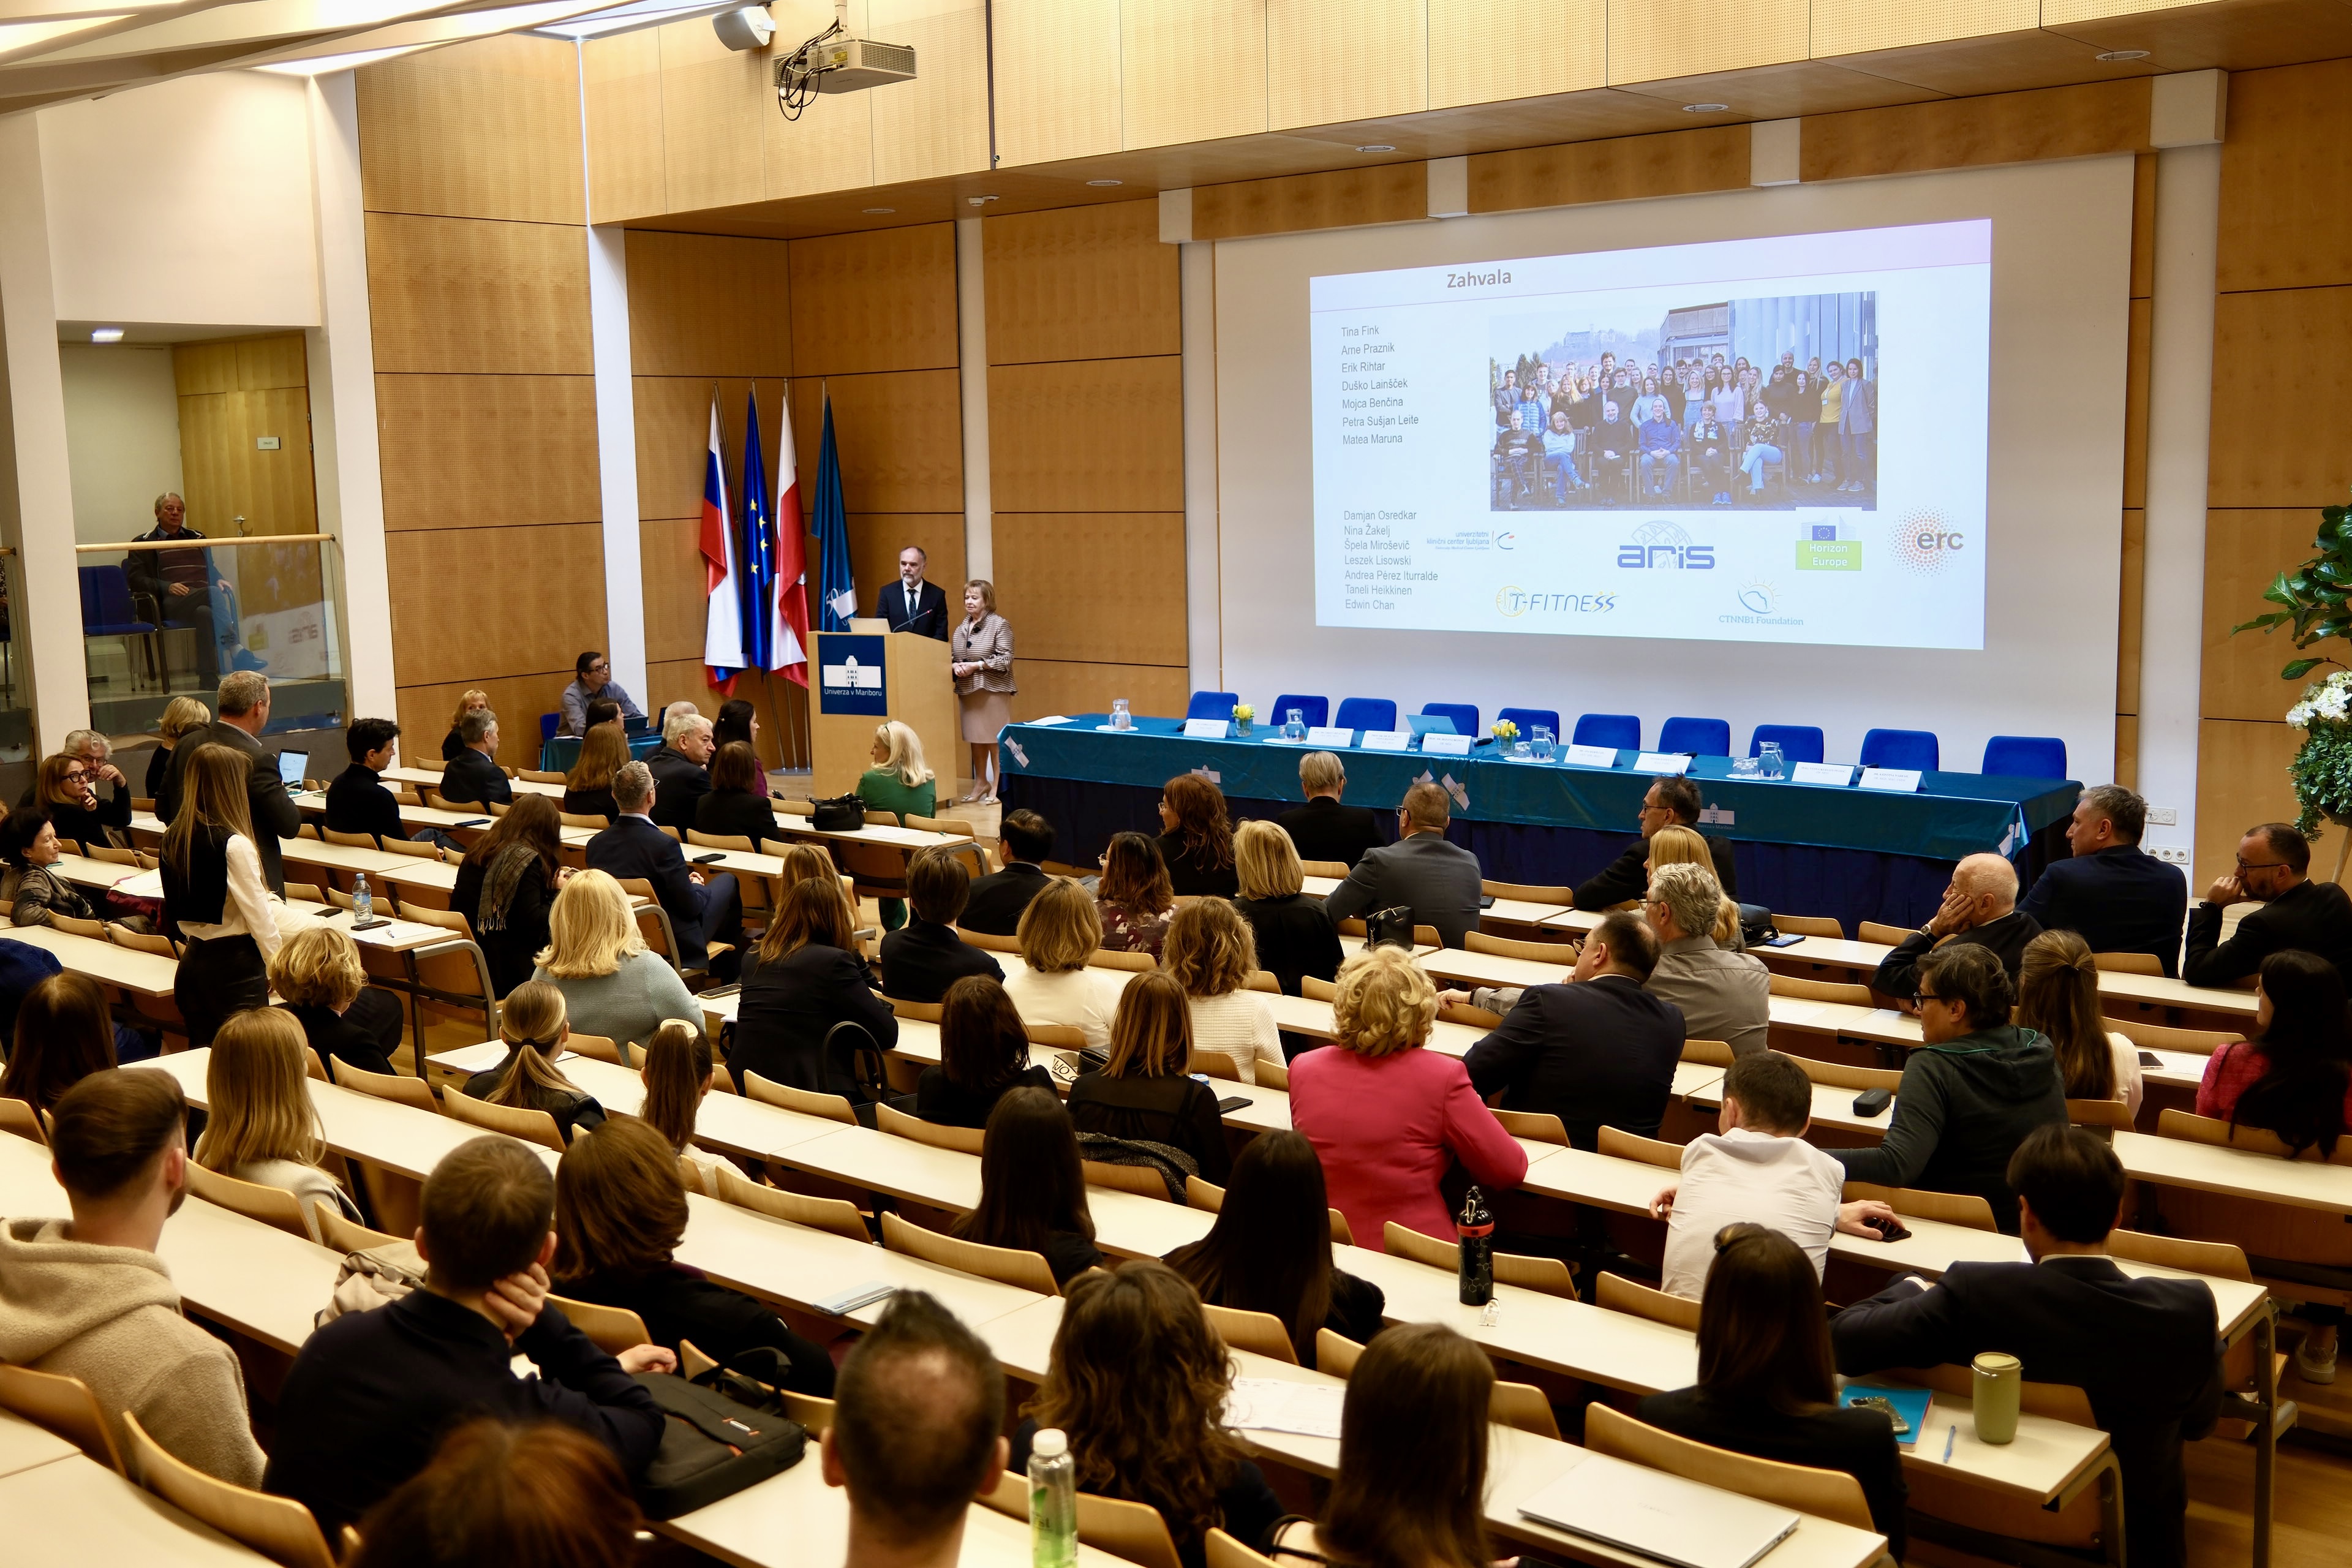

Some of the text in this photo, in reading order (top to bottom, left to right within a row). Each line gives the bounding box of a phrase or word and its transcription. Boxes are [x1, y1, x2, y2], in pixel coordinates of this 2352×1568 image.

[1447, 269, 1512, 288] Zahvala
[1341, 325, 1379, 337] Tina Fink
[1341, 342, 1395, 355] Arne Praznik
[1342, 361, 1385, 373] Erik Rihtar
[1342, 379, 1408, 391] Duško Lainšček
[1342, 397, 1403, 411] Mojca Benčina
[1343, 415, 1419, 428] Petra Sušjan Leite
[1343, 433, 1403, 445] Matea Maruna
[1344, 510, 1417, 522] Damjan Osredkar
[1344, 523, 1390, 538] Nina Žakelj
[1344, 538, 1368, 552] Špela
[1917, 532, 1964, 550] erc
[1809, 543, 1848, 553] Horizon
[1344, 555, 1411, 565] Leszek Lisowski
[1618, 545, 1715, 569] aris
[1812, 557, 1848, 568] Europe
[1344, 570, 1374, 580] Andrea
[1404, 571, 1438, 581] Iturralde
[1345, 584, 1412, 595] Taneli Heikkinen
[1345, 599, 1395, 610] Edwin Chan
[1719, 615, 1804, 625] CTNNB1 Foundation
